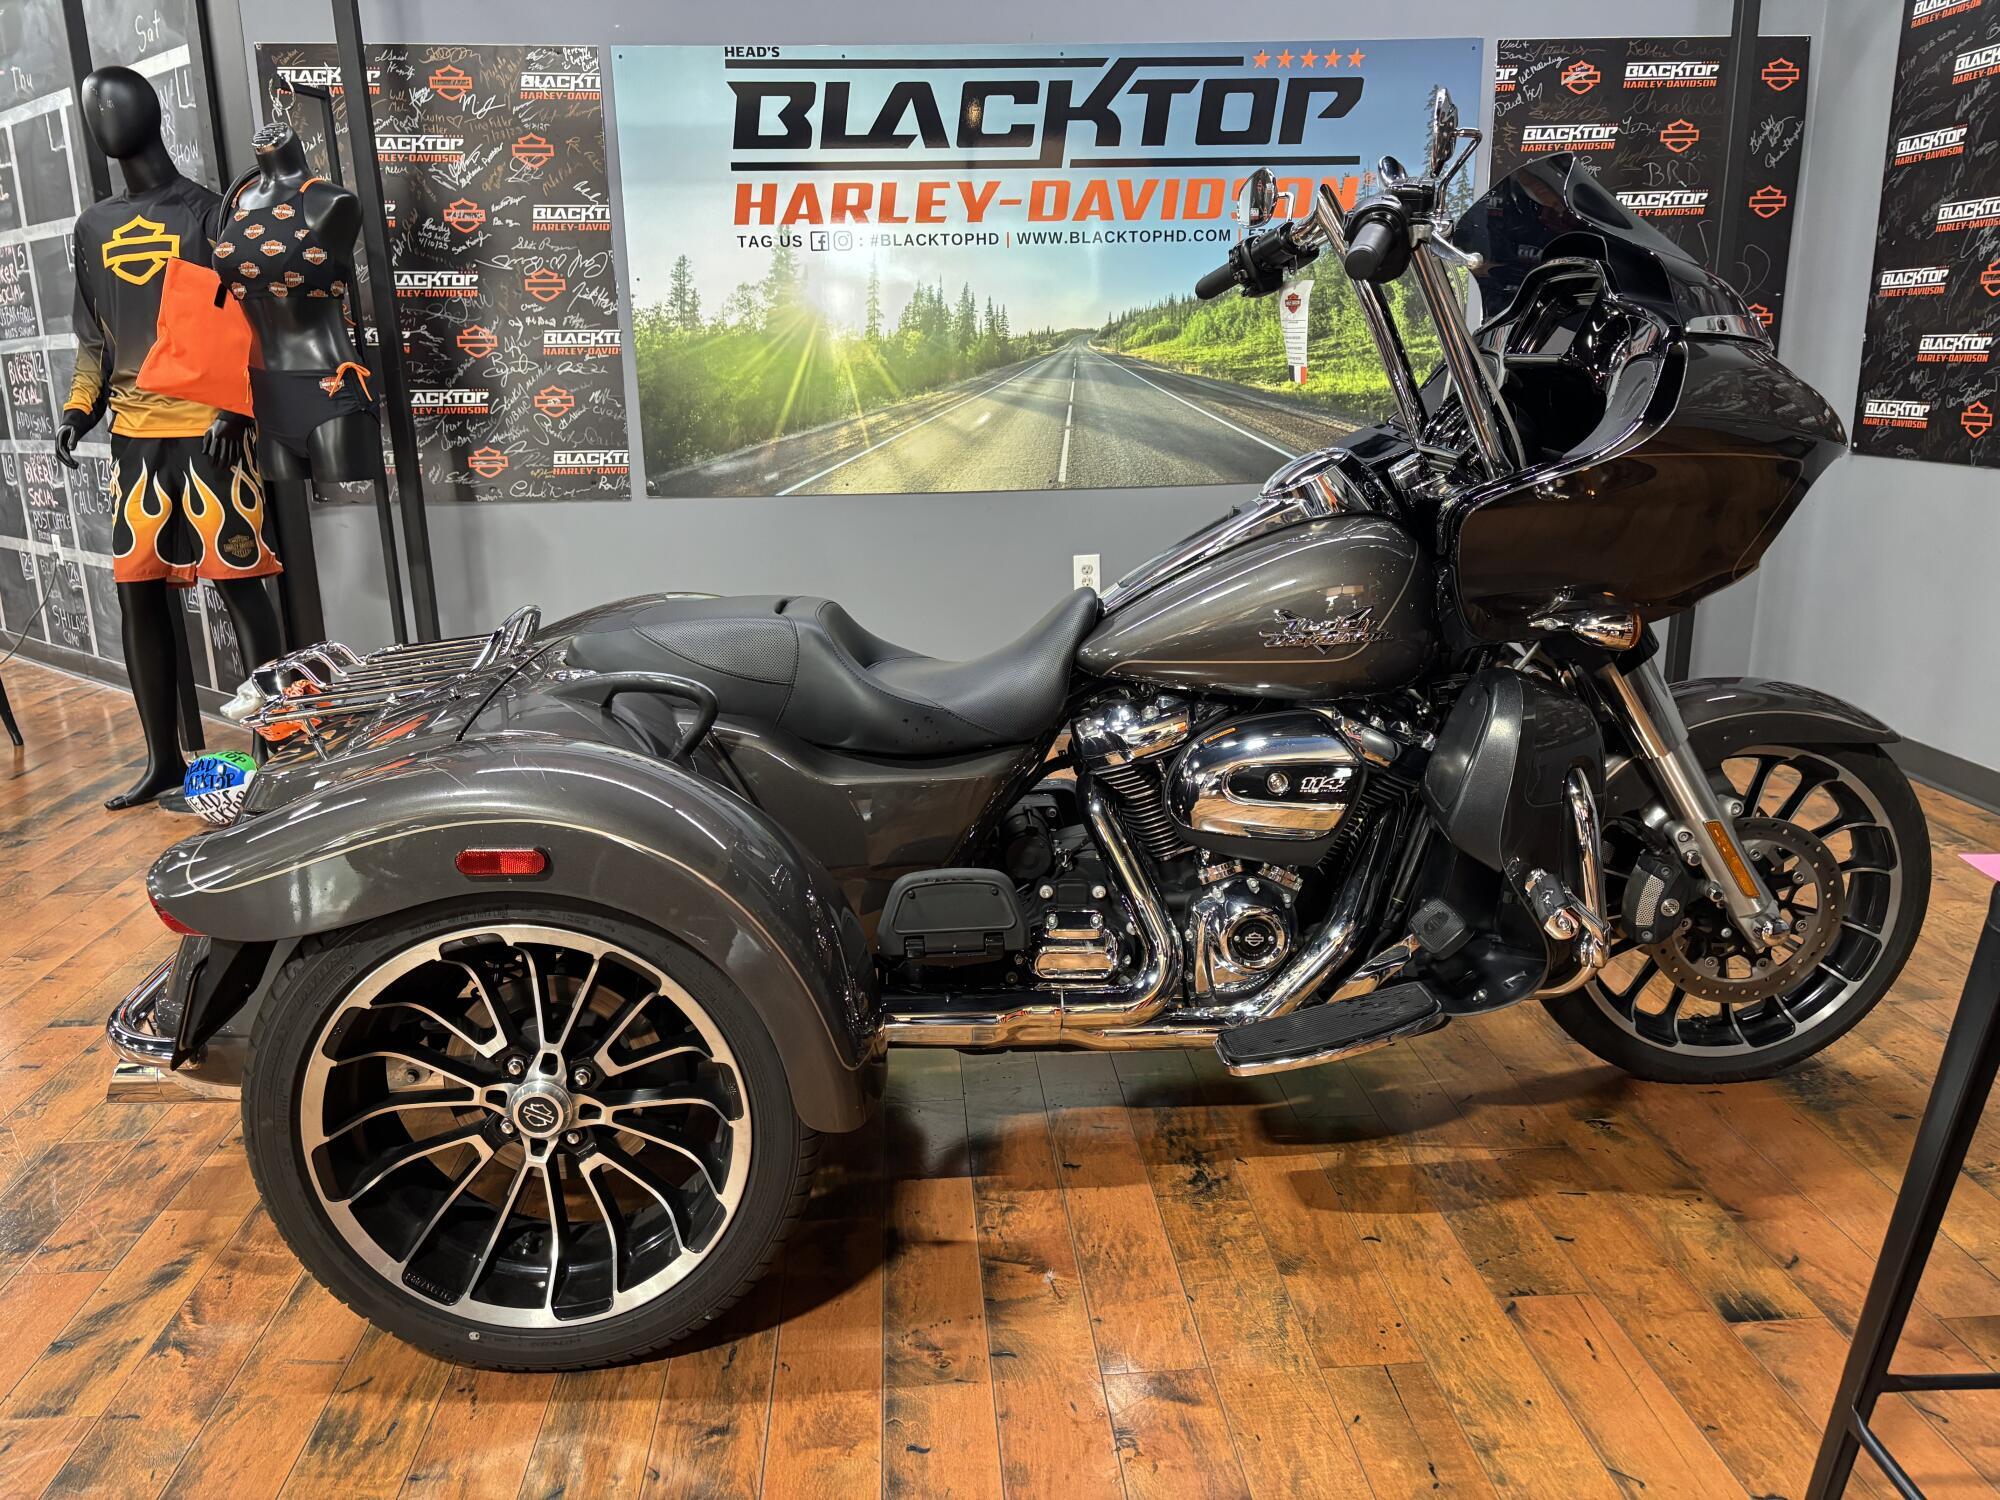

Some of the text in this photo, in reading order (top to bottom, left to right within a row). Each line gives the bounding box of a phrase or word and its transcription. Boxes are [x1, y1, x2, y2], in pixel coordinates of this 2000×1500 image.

[135, 10, 161, 51] Sat
[724, 45, 780, 58] HEAD'S
[1954, 44, 2000, 72] BLACK
[1625, 62, 1720, 79] BLACKTOP
[520, 75, 601, 91] BLACKT
[1623, 79, 1717, 89] HARLEY-DAVIDSON
[520, 92, 600, 100] HARLEY-DAVID
[726, 57, 1365, 168] BLACKTOP
[1522, 126, 1619, 142] BLACKTOP
[1897, 127, 1968, 154] BLACKTOP
[375, 136, 464, 153] LACKTOP
[1520, 142, 1616, 152] HARLEY-DAVIDSON
[377, 153, 464, 163] RLEY-DAVIDSON
[1895, 146, 1964, 166] HARLEY-DAVIDSON
[532, 206, 611, 222] BLACKT
[1632, 208, 1705, 217] LEY-DAVIDSON
[1937, 199, 2000, 221] BLACKTO
[532, 223, 611, 231] HARLEY-DAVID
[1936, 217, 2000, 232] HARLEY-DAVIDS
[737, 229, 1231, 249] TAG US #BLACKTOPHD WWW.BLACKTOPHD.COM
[394, 273, 479, 289] LACKTOP
[1881, 269, 1949, 287] BLACKTOP
[396, 289, 478, 298] LEY-DAVIDSON
[1879, 286, 1945, 297] HARLEY-DAVIDSON
[543, 331, 621, 346] BLACKT
[1919, 336, 1993, 351] BLACKTOP
[543, 347, 621, 356] HARLEY-DAVID
[1917, 354, 1989, 363] HARLEY-DAVIDSON
[8, 360, 38, 386] BIKER
[13, 384, 43, 406] SOCIAL
[410, 391, 489, 406] ACKTOP
[412, 406, 489, 415] LEY-DAVIDSON
[1864, 402, 1931, 418] BLACKTOP
[1863, 417, 1928, 429] HARLEY-DAVIDSON
[553, 451, 629, 466] BLACKT
[24, 461, 53, 487] BIKER
[552, 467, 629, 475] HARLEY-DAVID
[73, 489, 96, 516] CALL
[1301, 776, 1345, 790] 114
